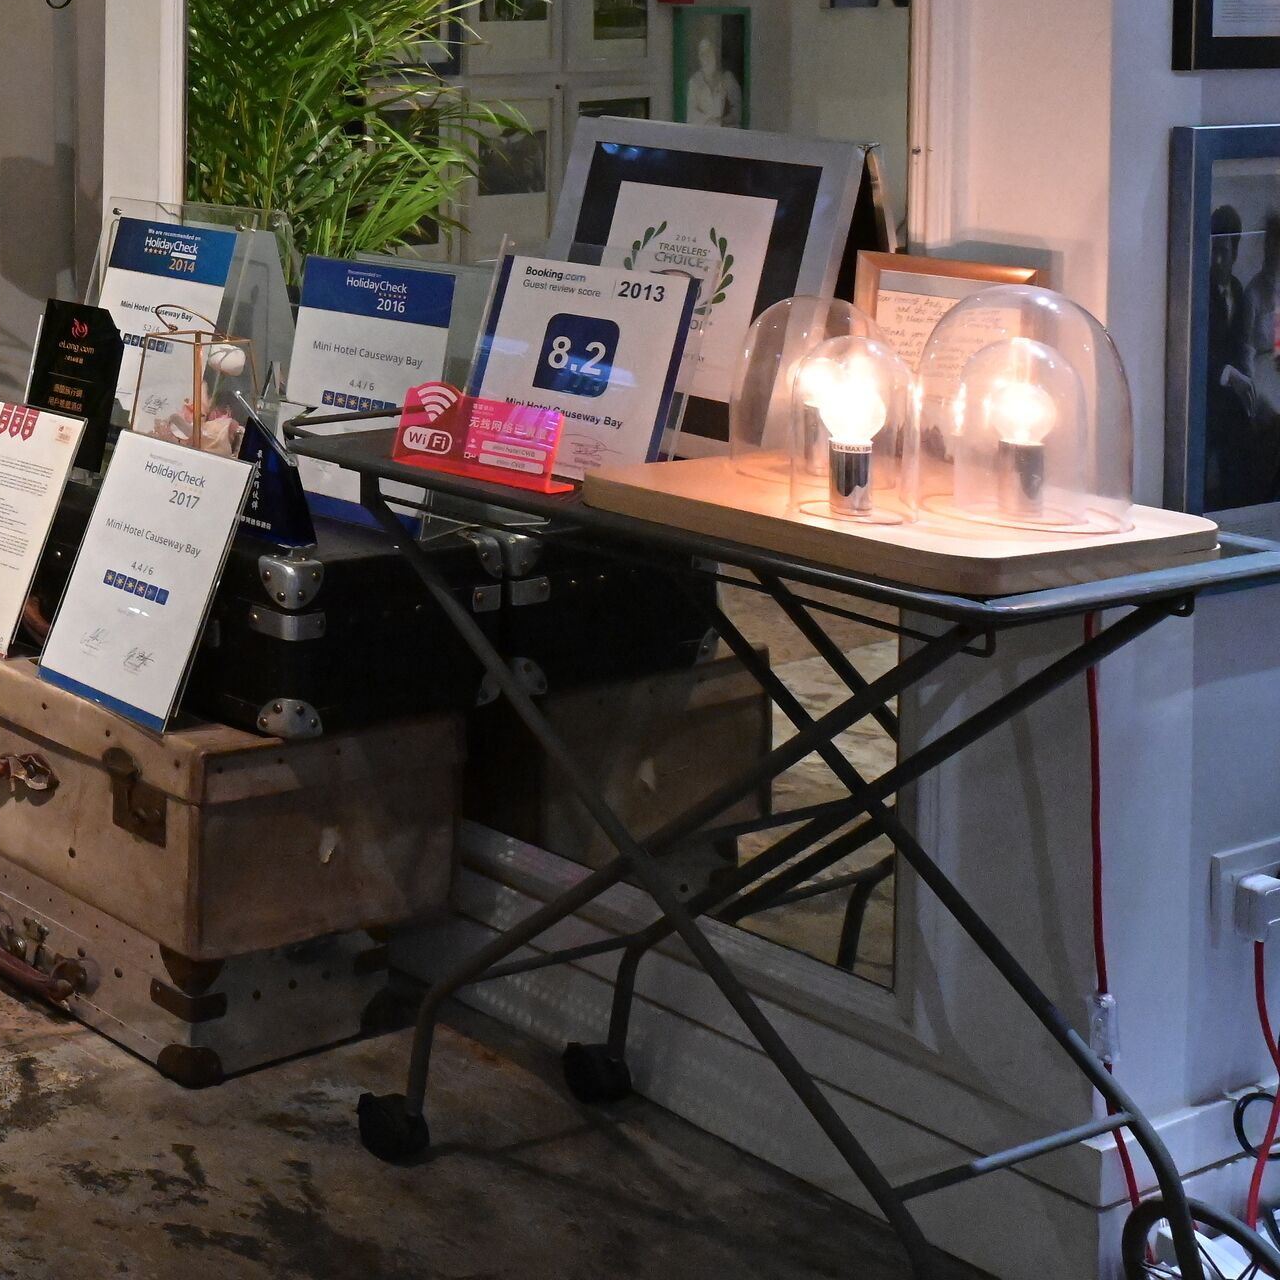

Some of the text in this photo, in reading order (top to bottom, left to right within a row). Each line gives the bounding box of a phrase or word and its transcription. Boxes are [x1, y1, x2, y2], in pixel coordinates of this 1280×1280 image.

[144, 236, 198, 254] HolidayCheck
[676, 234, 697, 243] 2014
[168, 258, 196, 273] 2014
[654, 251, 704, 268] CHOICE
[525, 266, 586, 284] Booking.com
[346, 276, 408, 294] HolidayCheck
[522, 279, 601, 298] Guest review score
[618, 280, 665, 302] 2013
[120, 300, 133, 309] Mini
[134, 303, 150, 313] Hotel
[181, 311, 194, 322] Bay
[376, 298, 406, 314] 2016
[312, 340, 423, 370] Mini Hotel Causeway Bay
[548, 336, 606, 376] 8.2
[349, 378, 362, 389] 4.4
[604, 416, 624, 430] Bay
[144, 460, 206, 488] HolidayCheck
[169, 490, 200, 510] 2017
[106, 518, 201, 558] Mini Hotel Causeway Bay
[131, 561, 143, 572] 4.4
